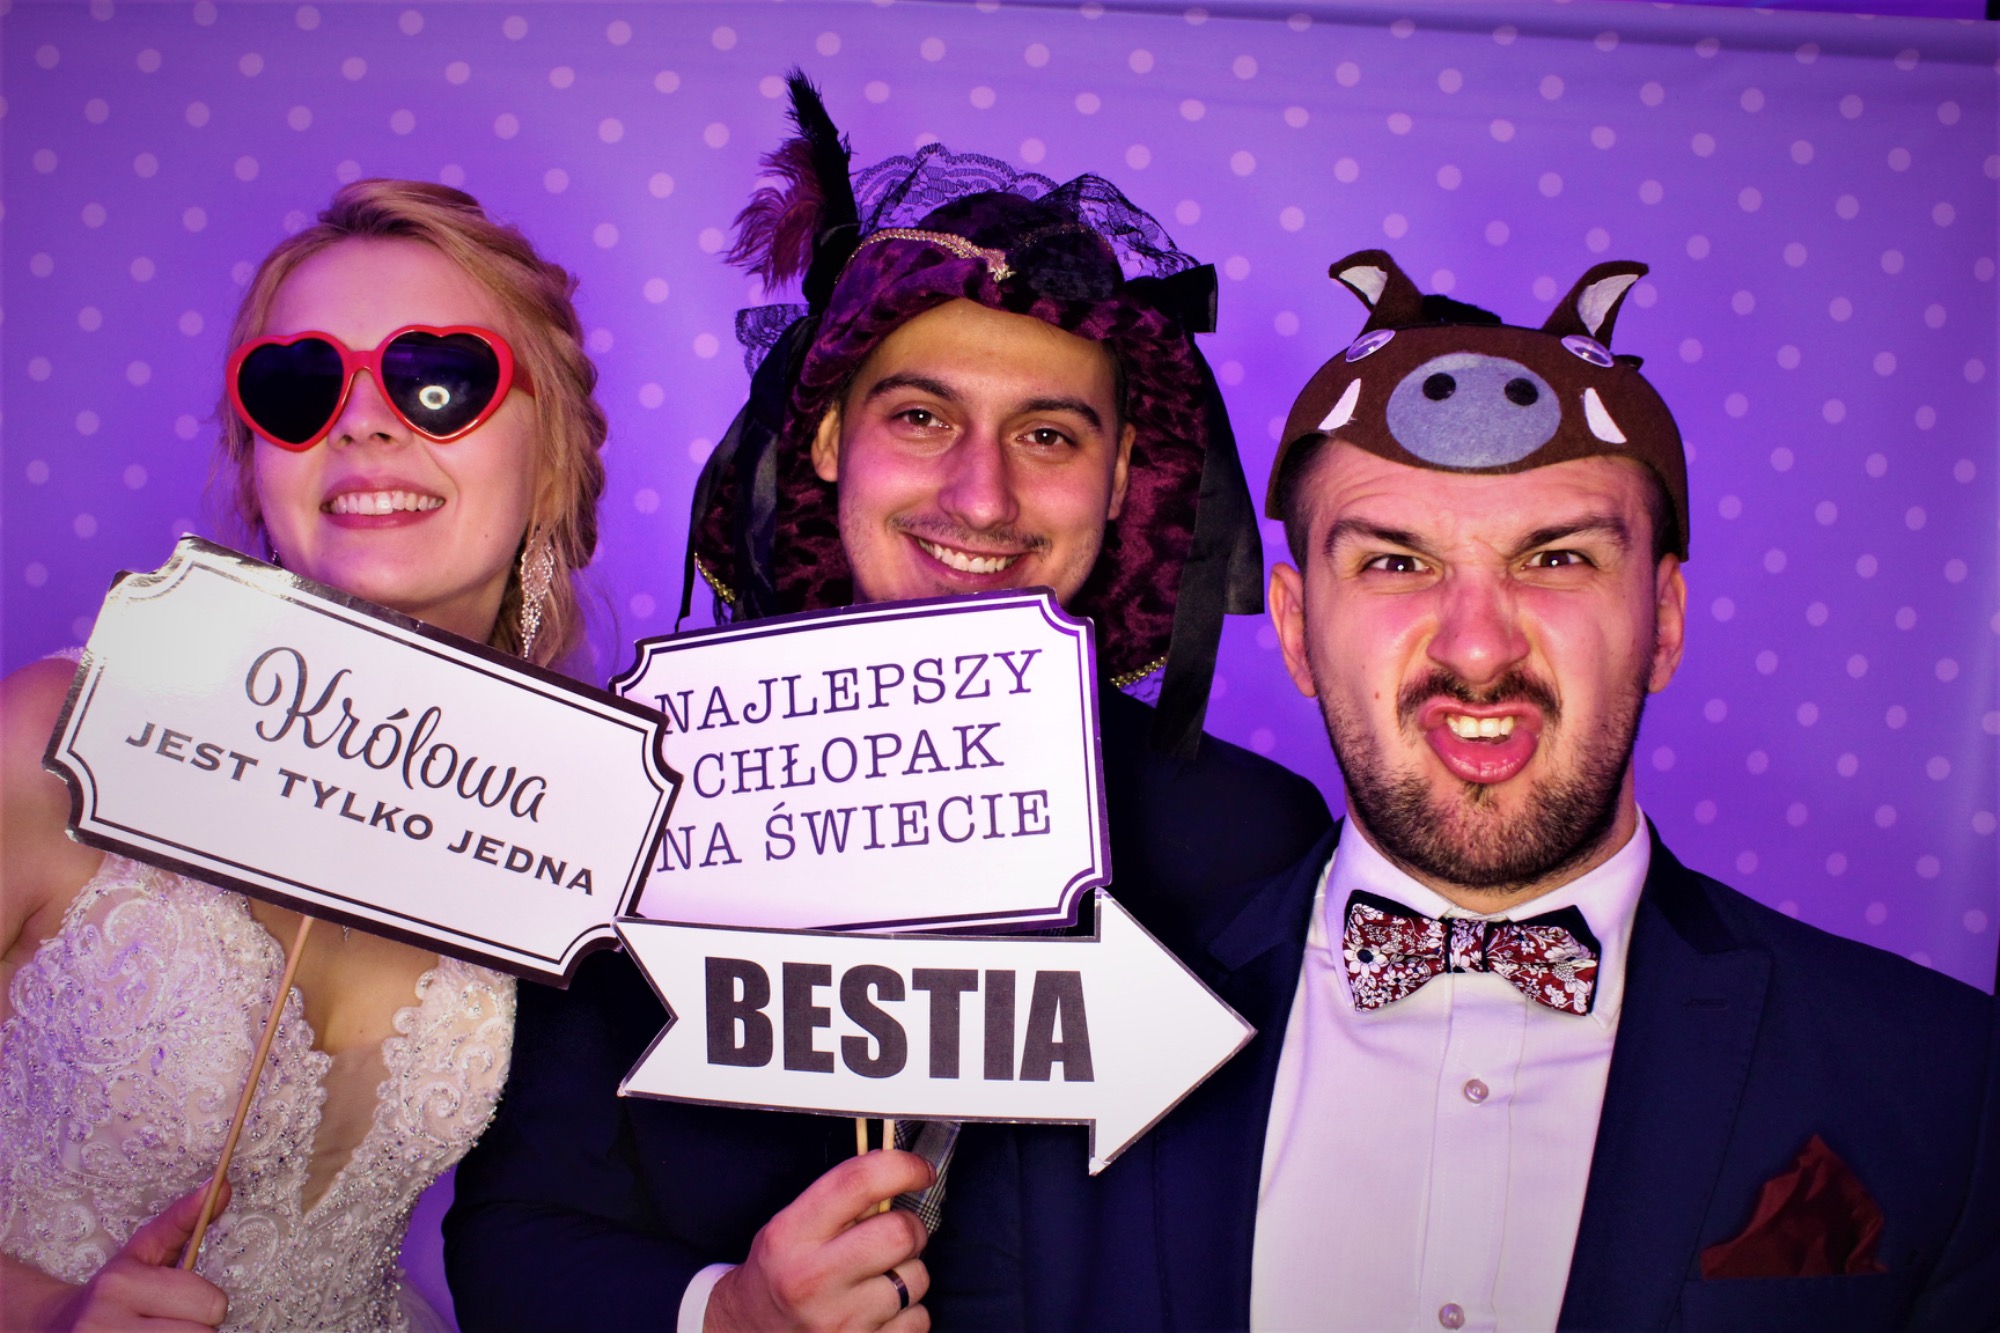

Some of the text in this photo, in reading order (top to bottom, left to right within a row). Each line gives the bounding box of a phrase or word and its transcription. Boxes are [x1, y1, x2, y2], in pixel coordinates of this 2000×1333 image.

[246, 647, 547, 823] Królowa
[654, 649, 1042, 735] NAJLEPSZY
[125, 722, 595, 896] JEST TYLKO JEDNA
[693, 722, 1004, 798] CHŁOPAK
[656, 789, 1051, 872] NA ŚWIECIE
[705, 956, 1095, 1083] BESTIA
